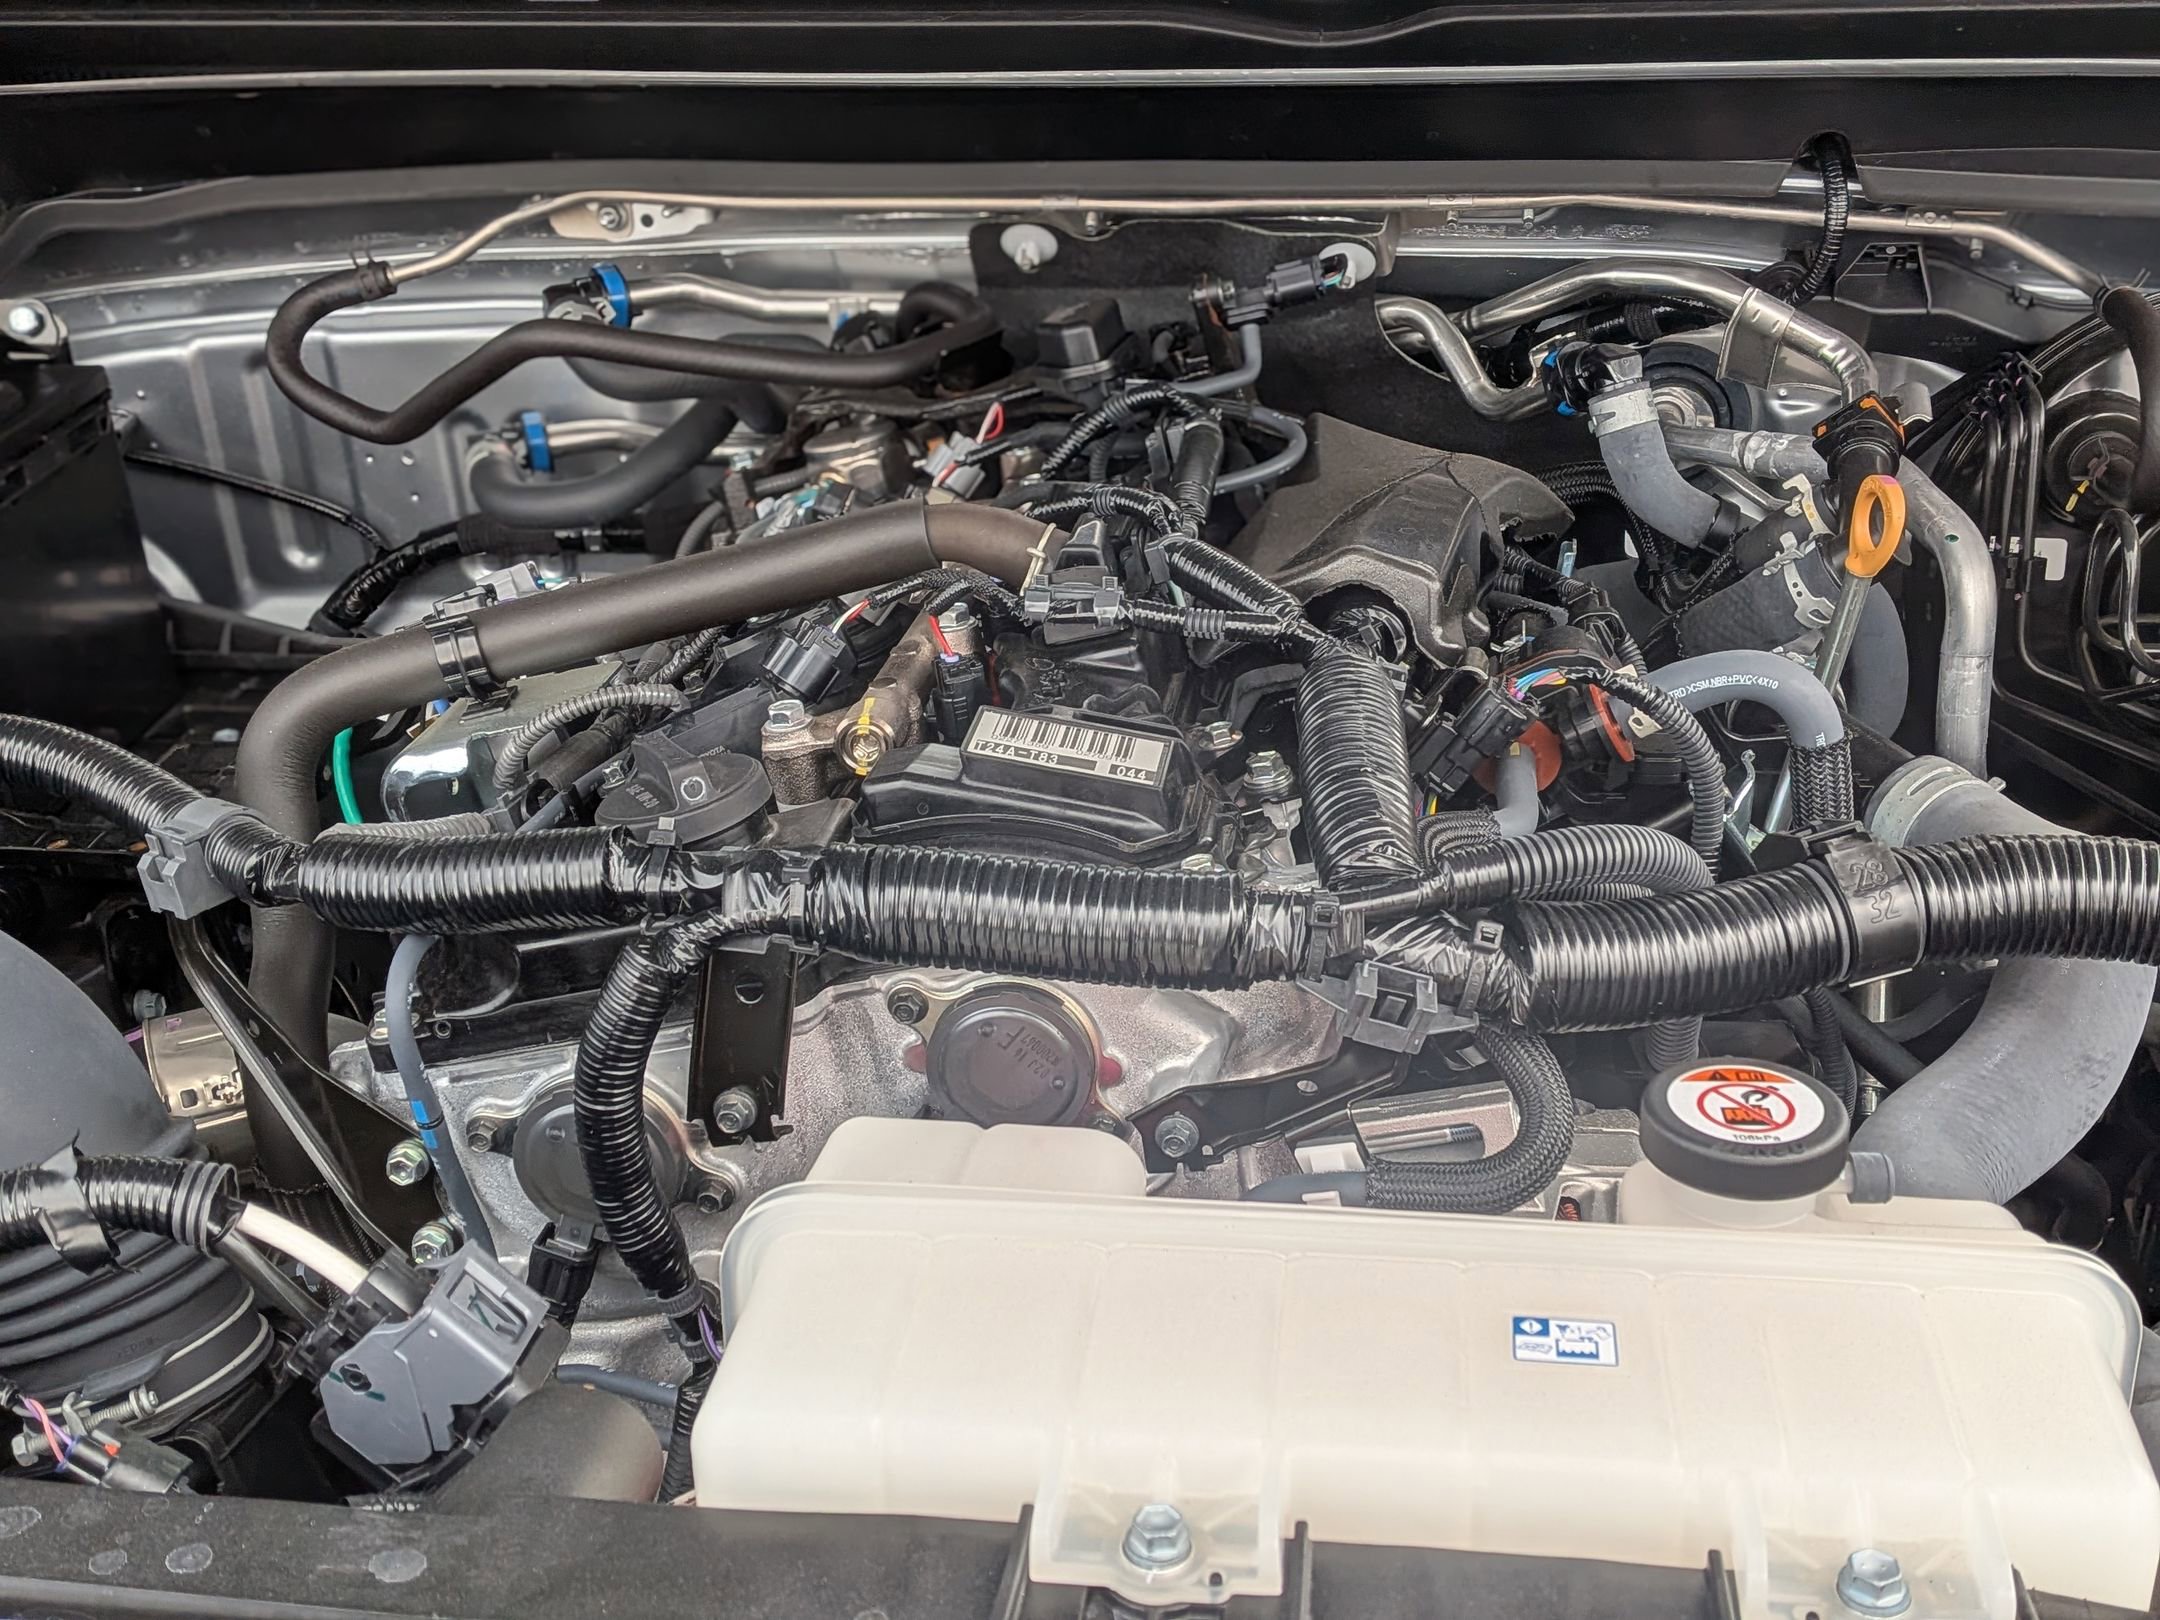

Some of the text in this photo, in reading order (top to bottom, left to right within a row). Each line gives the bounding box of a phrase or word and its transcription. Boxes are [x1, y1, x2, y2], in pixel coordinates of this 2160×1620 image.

[976, 741, 1059, 765] T24A-T83
[1116, 767, 1147, 780] 044
[1849, 857, 1889, 891] 28
[1863, 889, 1903, 924] 32
